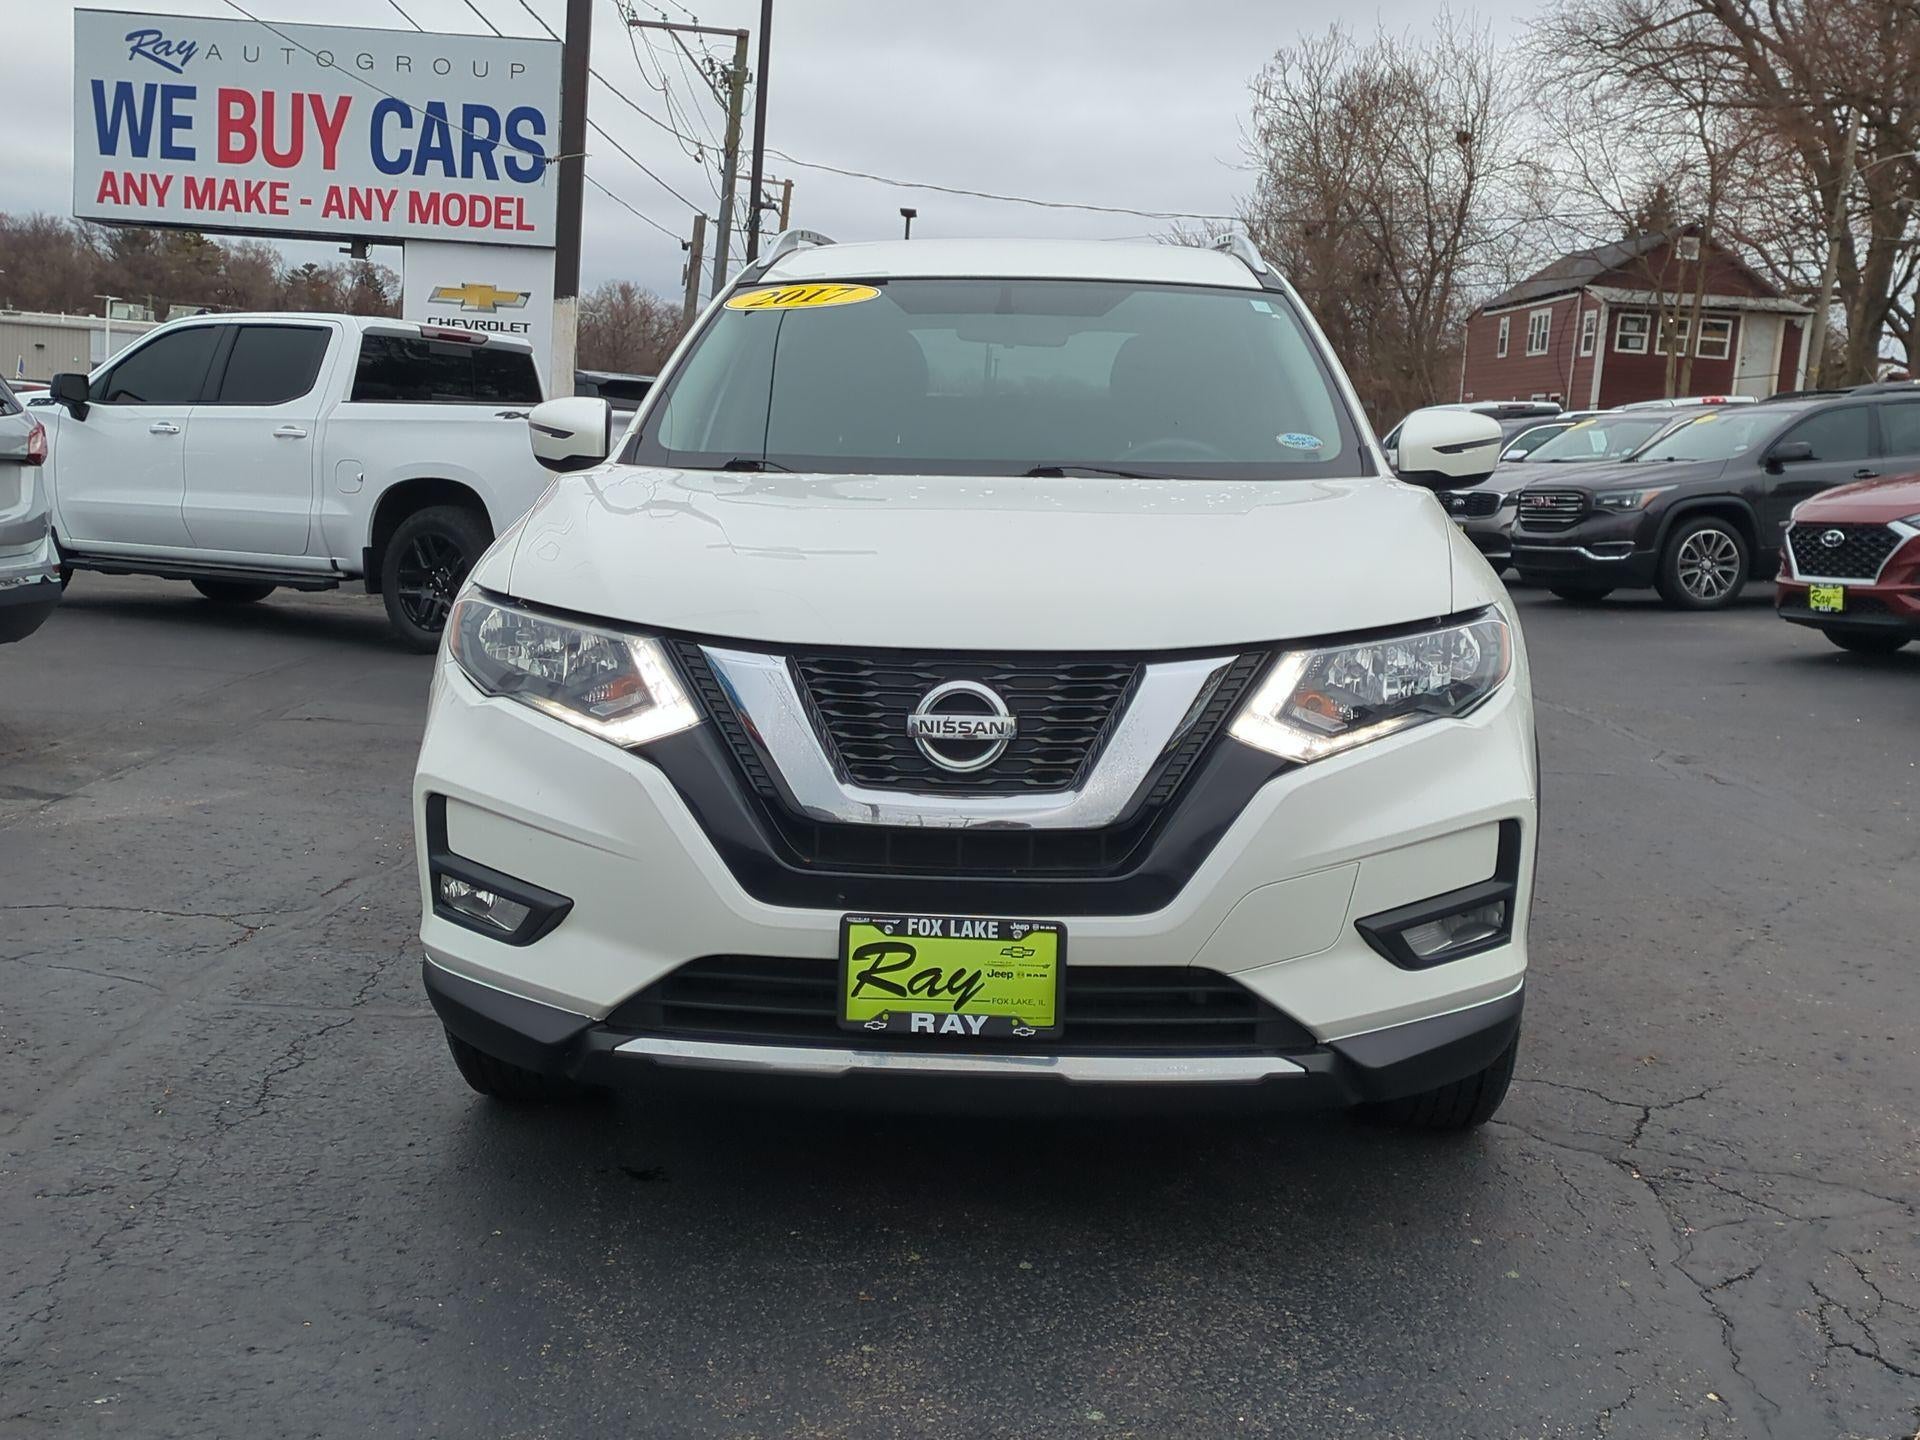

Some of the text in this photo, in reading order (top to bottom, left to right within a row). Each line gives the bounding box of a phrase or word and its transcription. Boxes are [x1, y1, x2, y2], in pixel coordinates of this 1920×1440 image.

[125, 29, 199, 74] Ray
[91, 79, 546, 184] WE BUY CARS
[96, 170, 173, 207] ANY
[184, 176, 290, 215] MAKE
[321, 185, 399, 222] ANY
[408, 190, 535, 231] MODEL
[745, 287, 859, 307] 2017
[919, 720, 1005, 735] NISSAN
[907, 918, 999, 939] FOX LAKE
[1010, 922, 1030, 931] Jeep
[851, 941, 985, 1012] Ray
[987, 969, 1014, 979] Jeep
[910, 1012, 989, 1035] RAY
